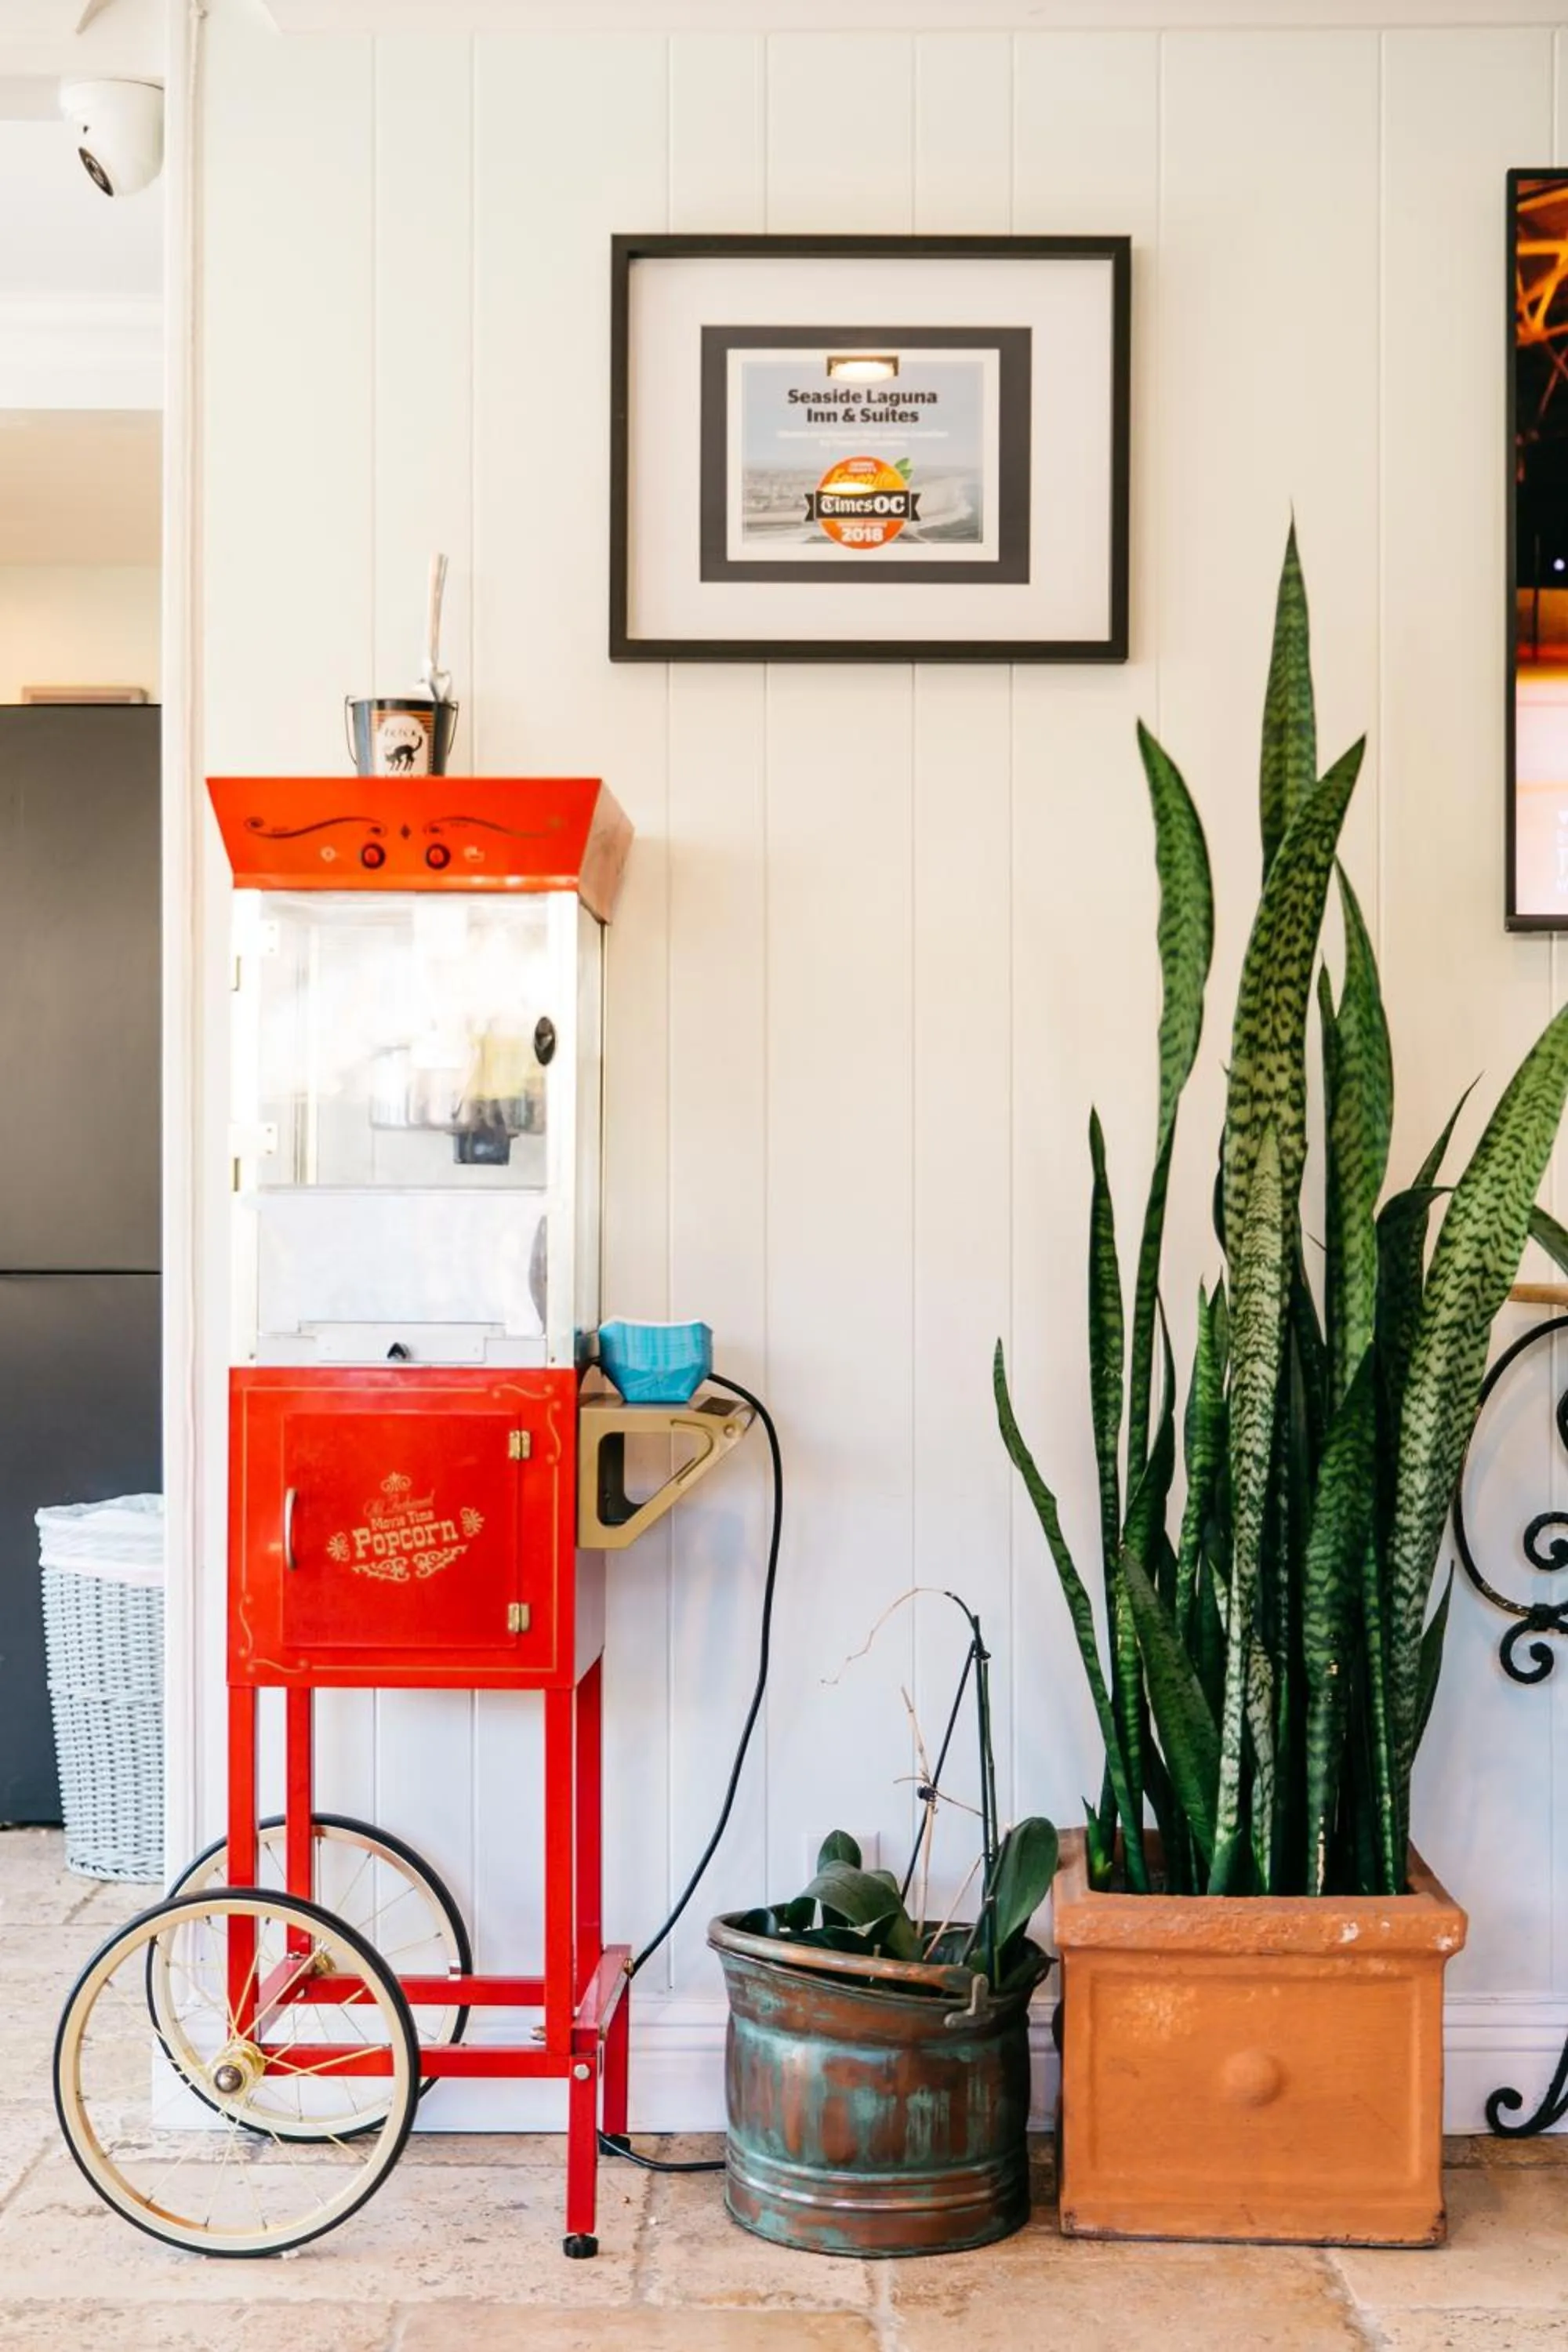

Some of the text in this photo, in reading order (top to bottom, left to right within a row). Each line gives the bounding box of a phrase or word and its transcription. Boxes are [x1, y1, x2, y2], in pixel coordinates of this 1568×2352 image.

[787, 389, 938, 406] Seaside Laguna
[806, 408, 920, 423] Inn & Suites
[841, 528, 884, 542] 2018
[352, 1520, 459, 1559] Popcorn
